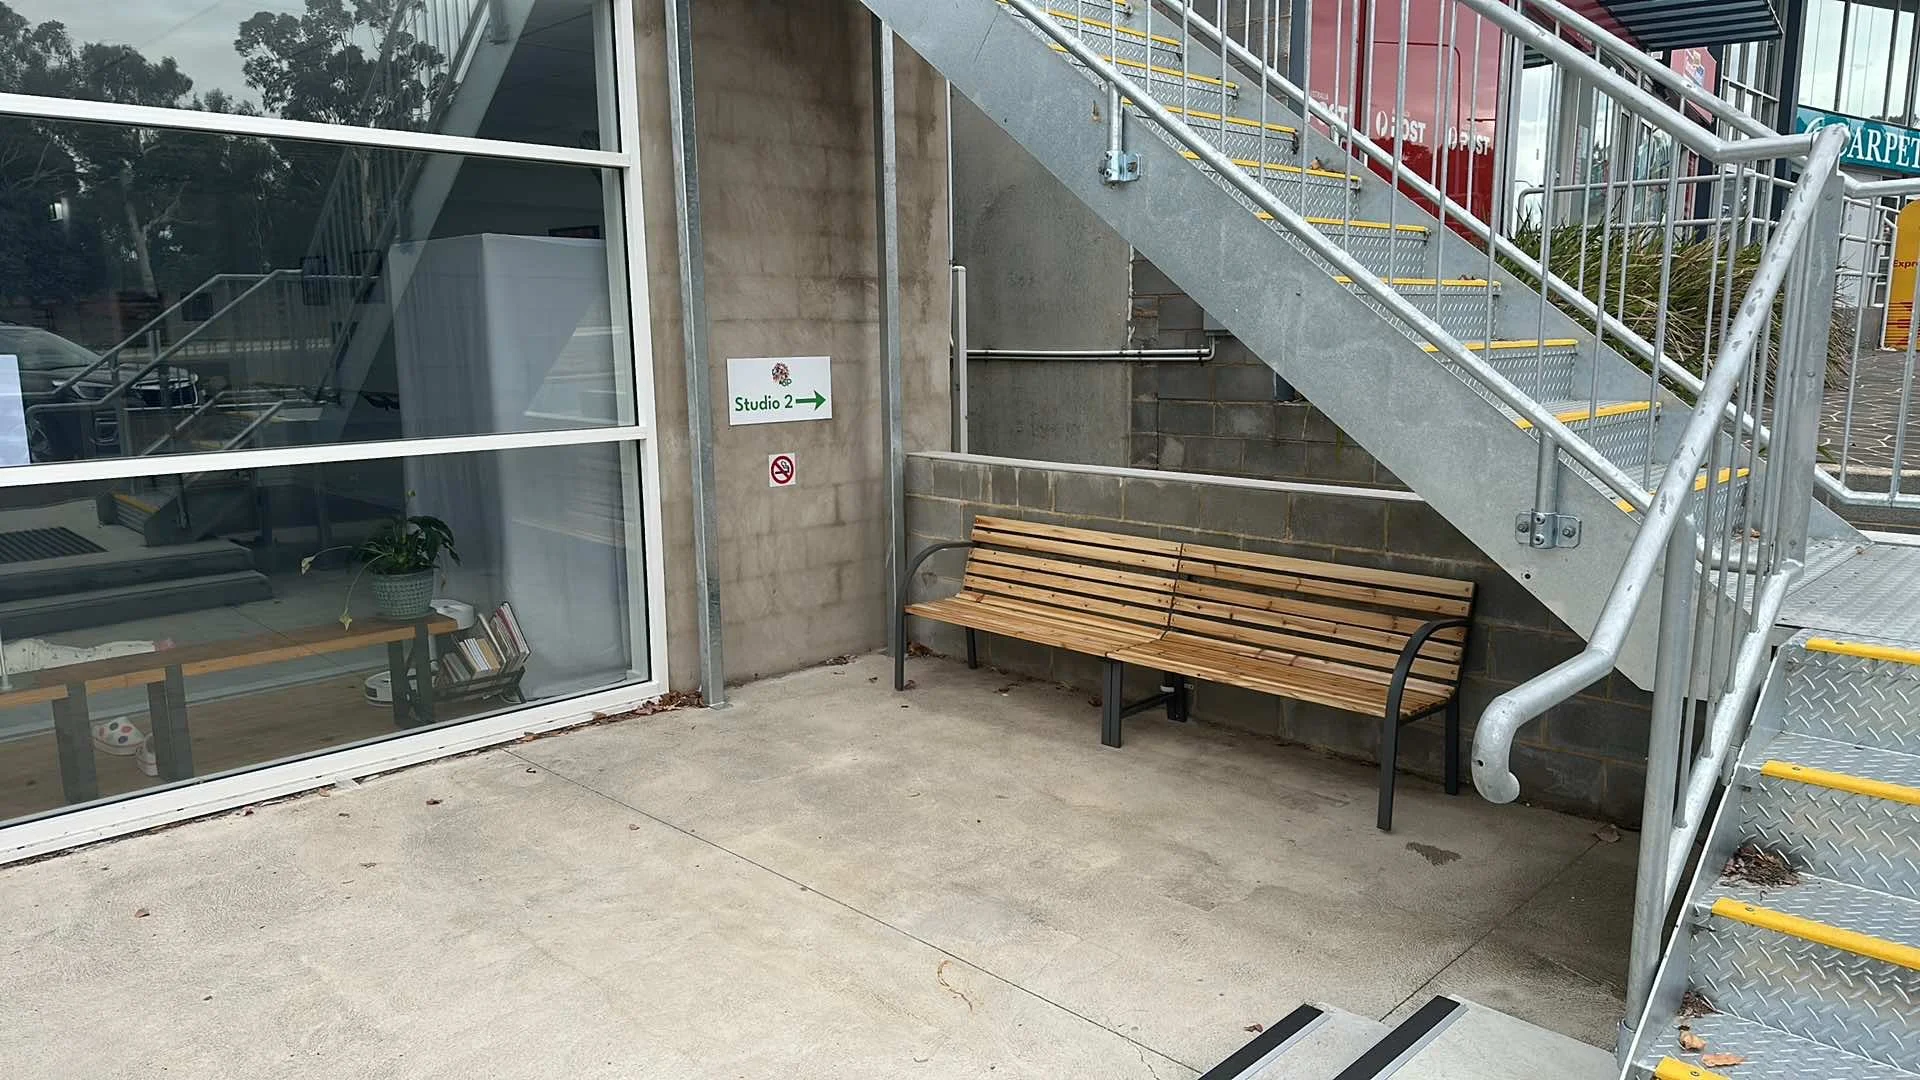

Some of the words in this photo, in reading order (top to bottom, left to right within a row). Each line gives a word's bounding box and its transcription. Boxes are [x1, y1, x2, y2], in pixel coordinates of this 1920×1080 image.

[1459, 131, 1490, 155] PST
[1806, 117, 1920, 169] ARPET
[1893, 259, 1919, 269] Expr
[735, 395, 780, 412] Studio
[784, 394, 793, 409] 2
